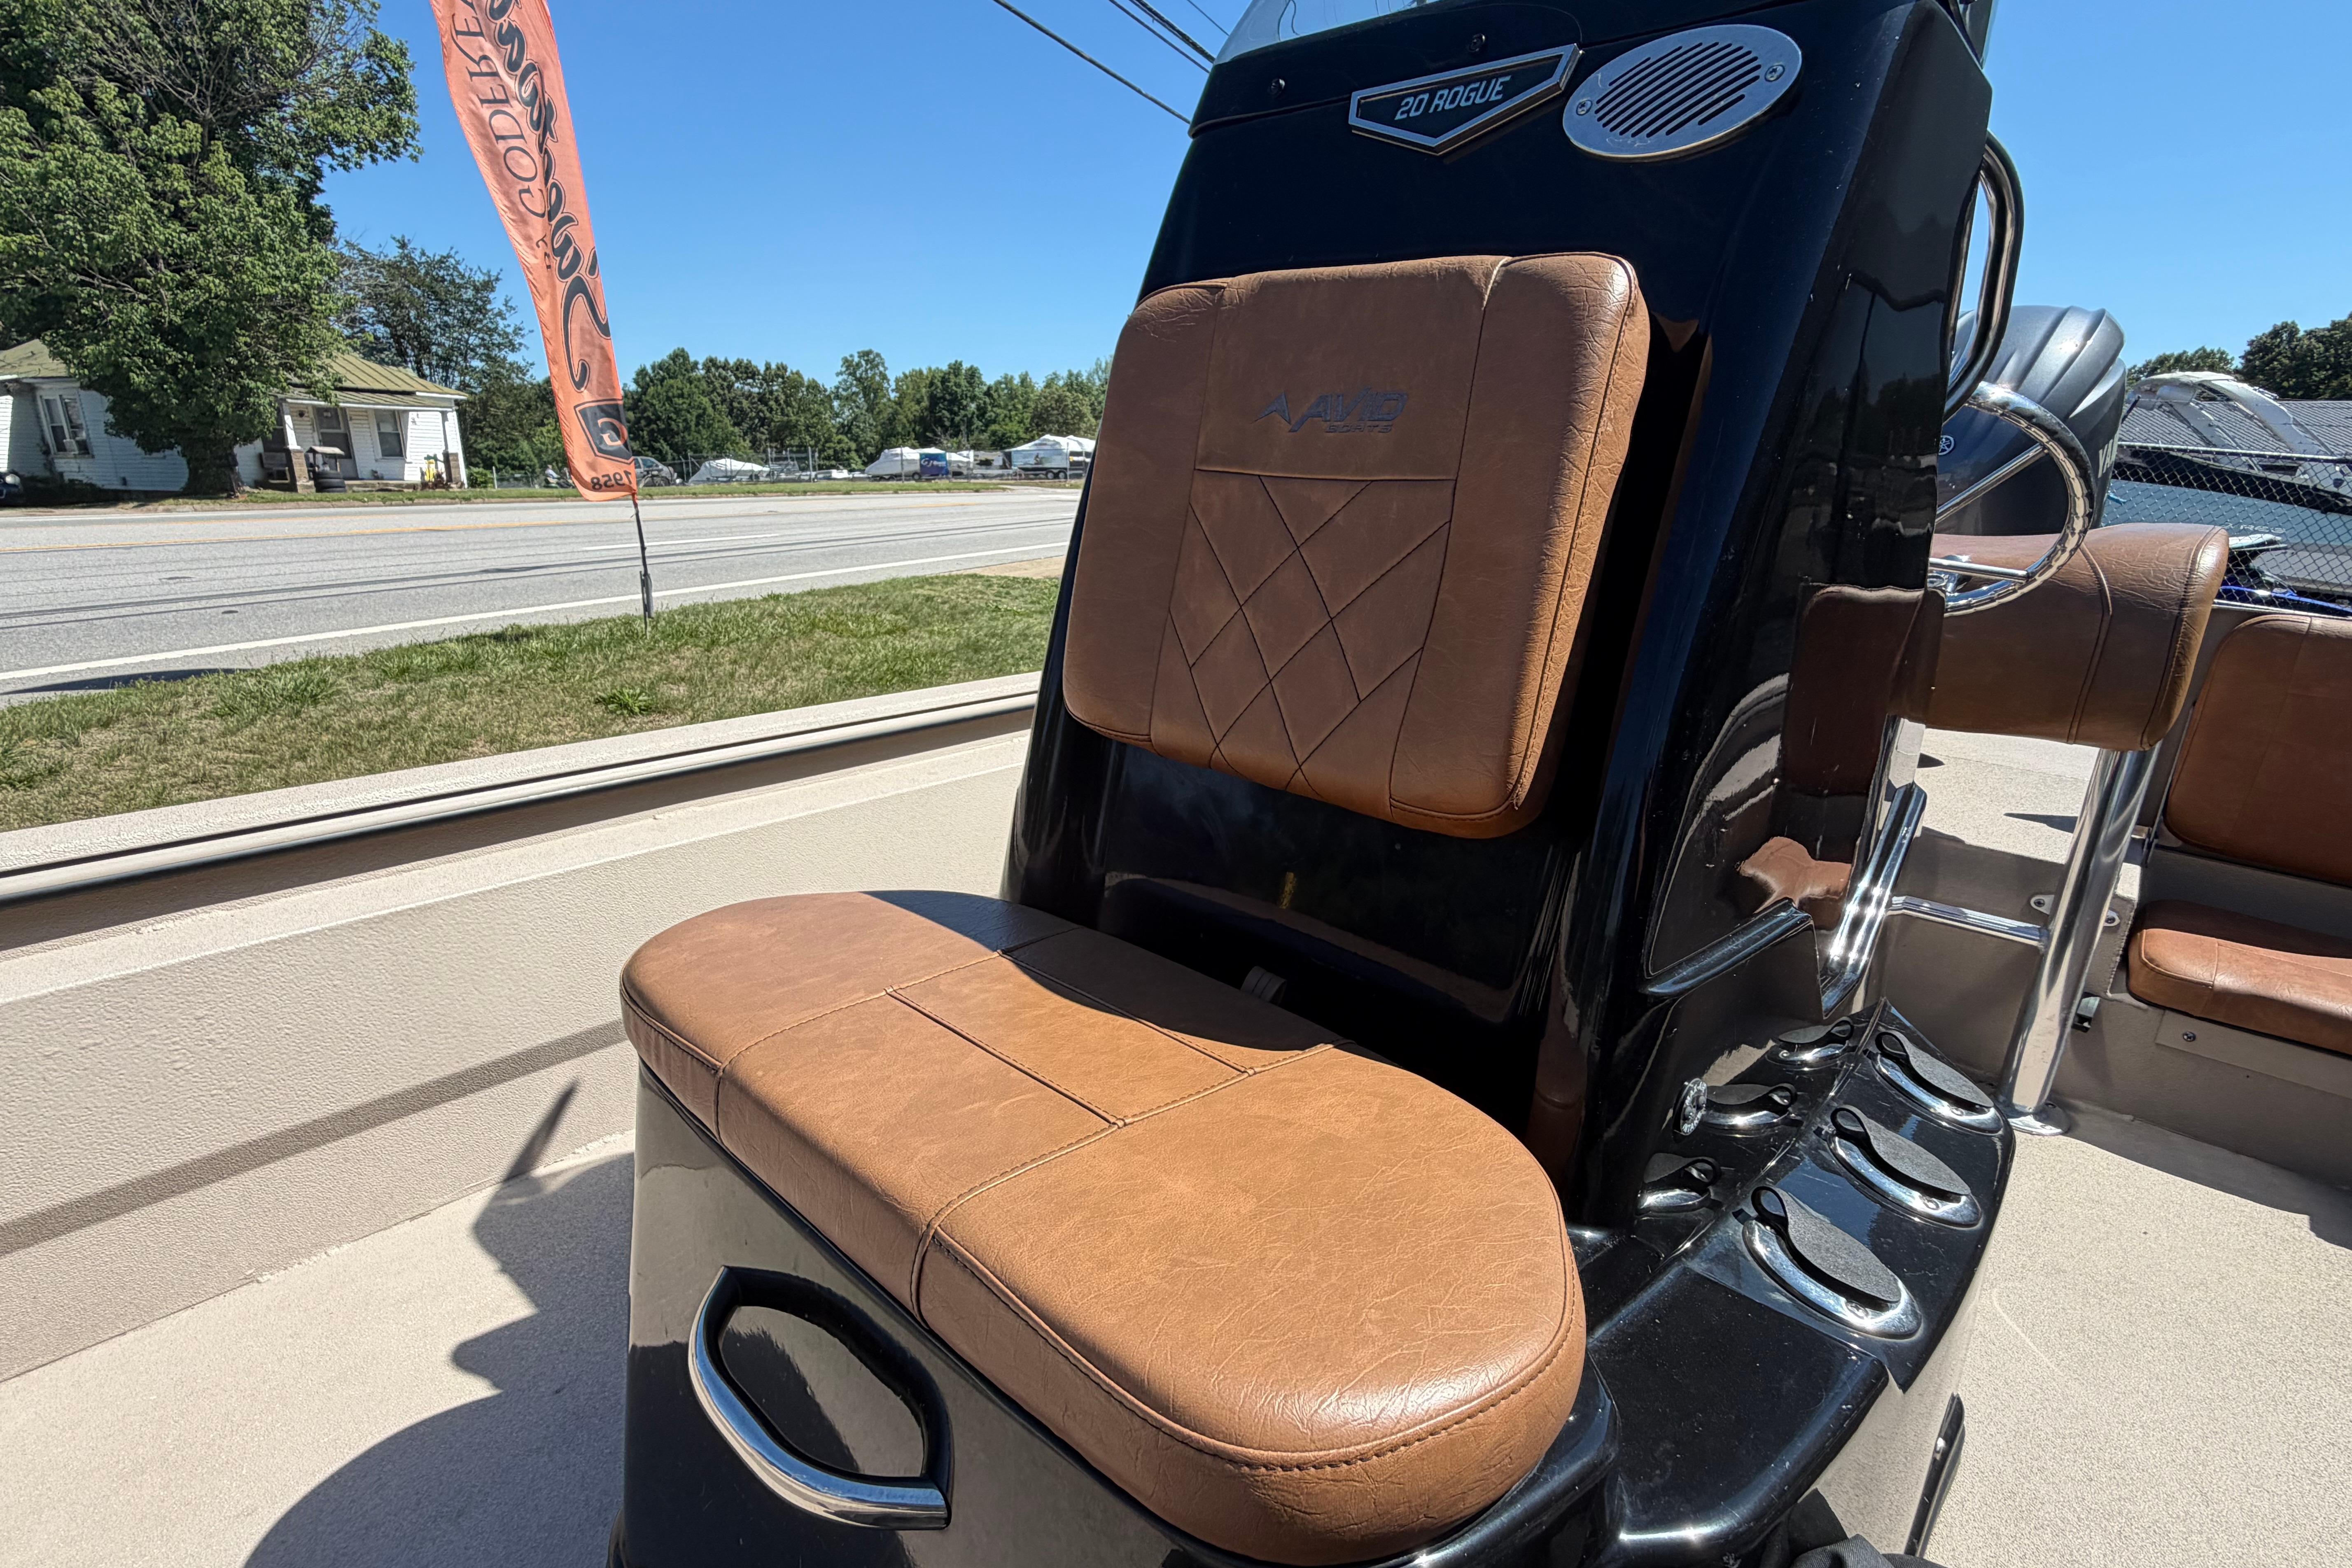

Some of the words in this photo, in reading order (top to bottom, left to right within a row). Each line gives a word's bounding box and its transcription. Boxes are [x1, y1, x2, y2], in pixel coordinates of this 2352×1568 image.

[1394, 93, 1430, 120] 20
[1428, 75, 1512, 113] ROGUE
[1289, 386, 1409, 433] AVID
